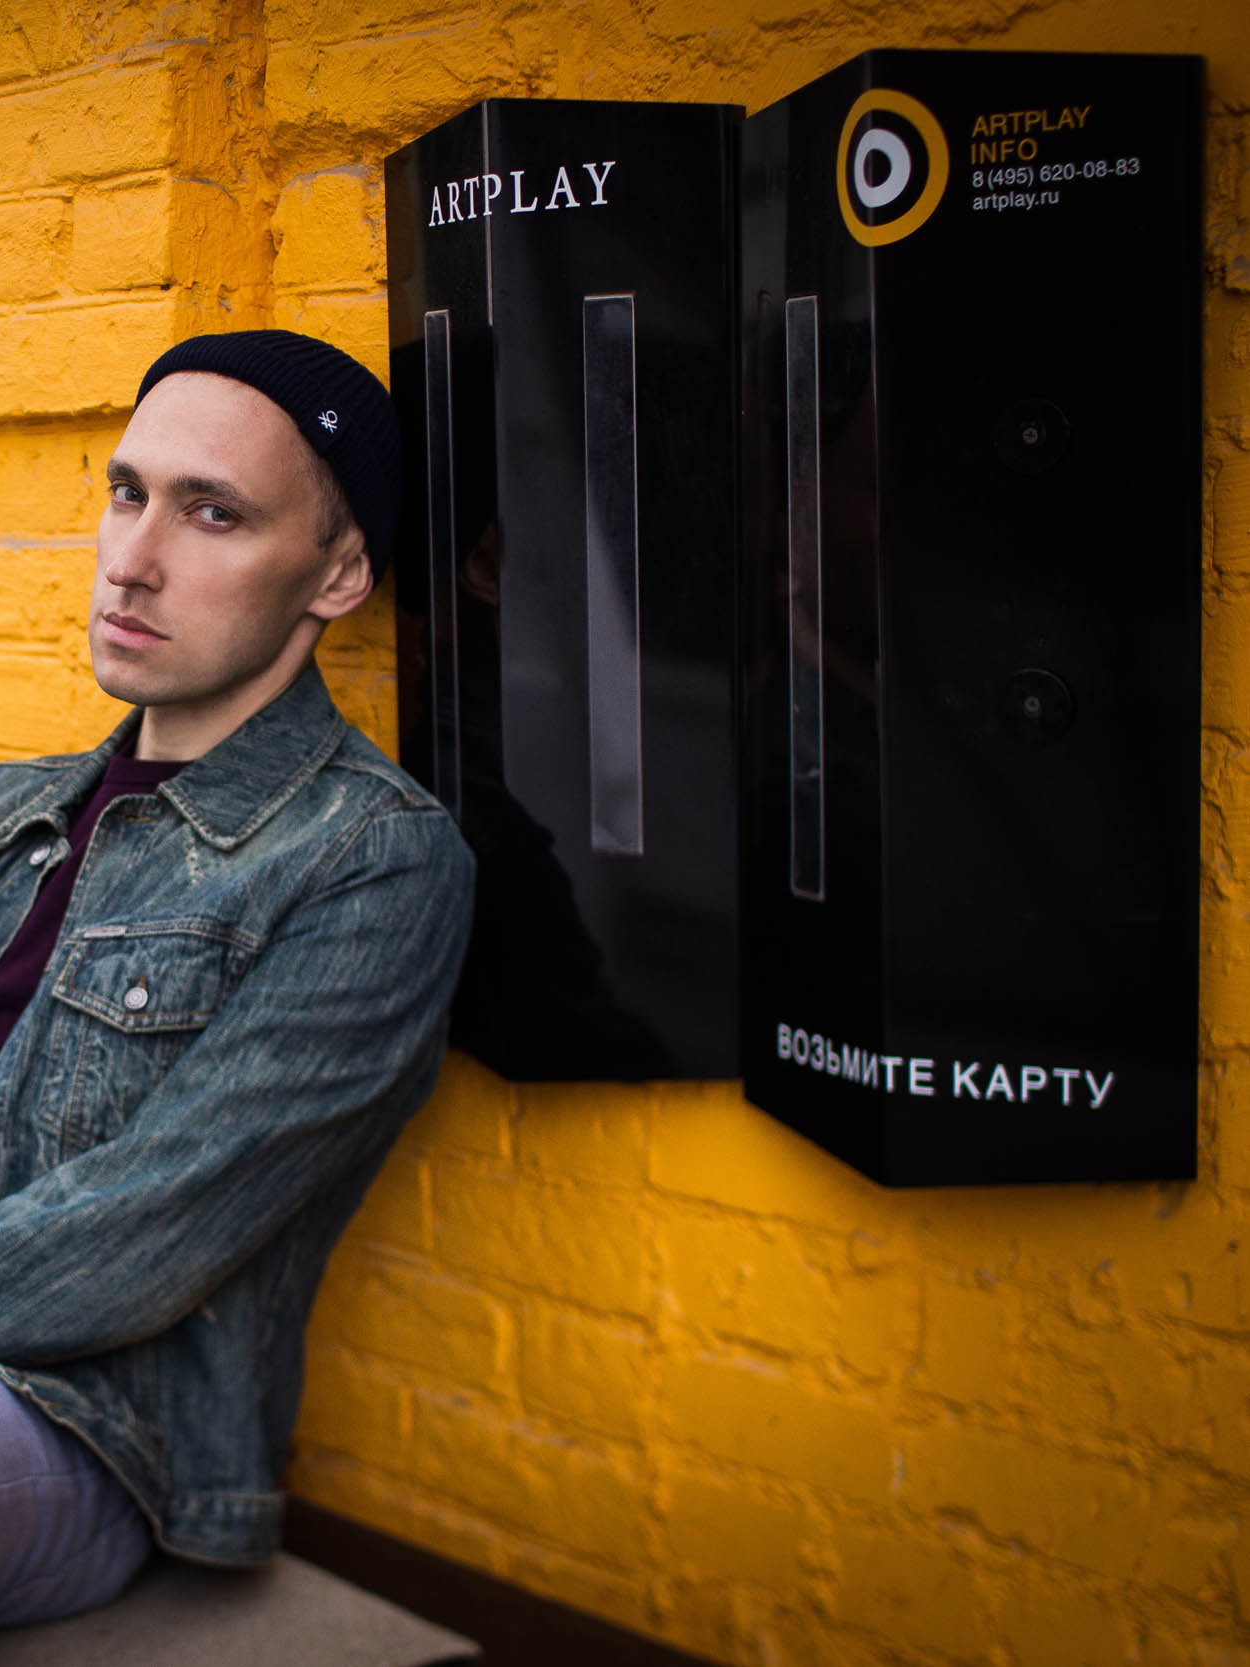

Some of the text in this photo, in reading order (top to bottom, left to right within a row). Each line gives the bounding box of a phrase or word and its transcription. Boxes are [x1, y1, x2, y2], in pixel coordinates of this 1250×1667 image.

[971, 106, 1090, 138] ARTPLAY
[971, 138, 1038, 165] INFO
[972, 157, 1140, 190] 8 (495) 620-08-83
[428, 161, 616, 227] ARTPLAY
[972, 190, 1060, 212] artplay.ru
[777, 1022, 1114, 1109] ВОЗЬМИТЕ КАРТУ
